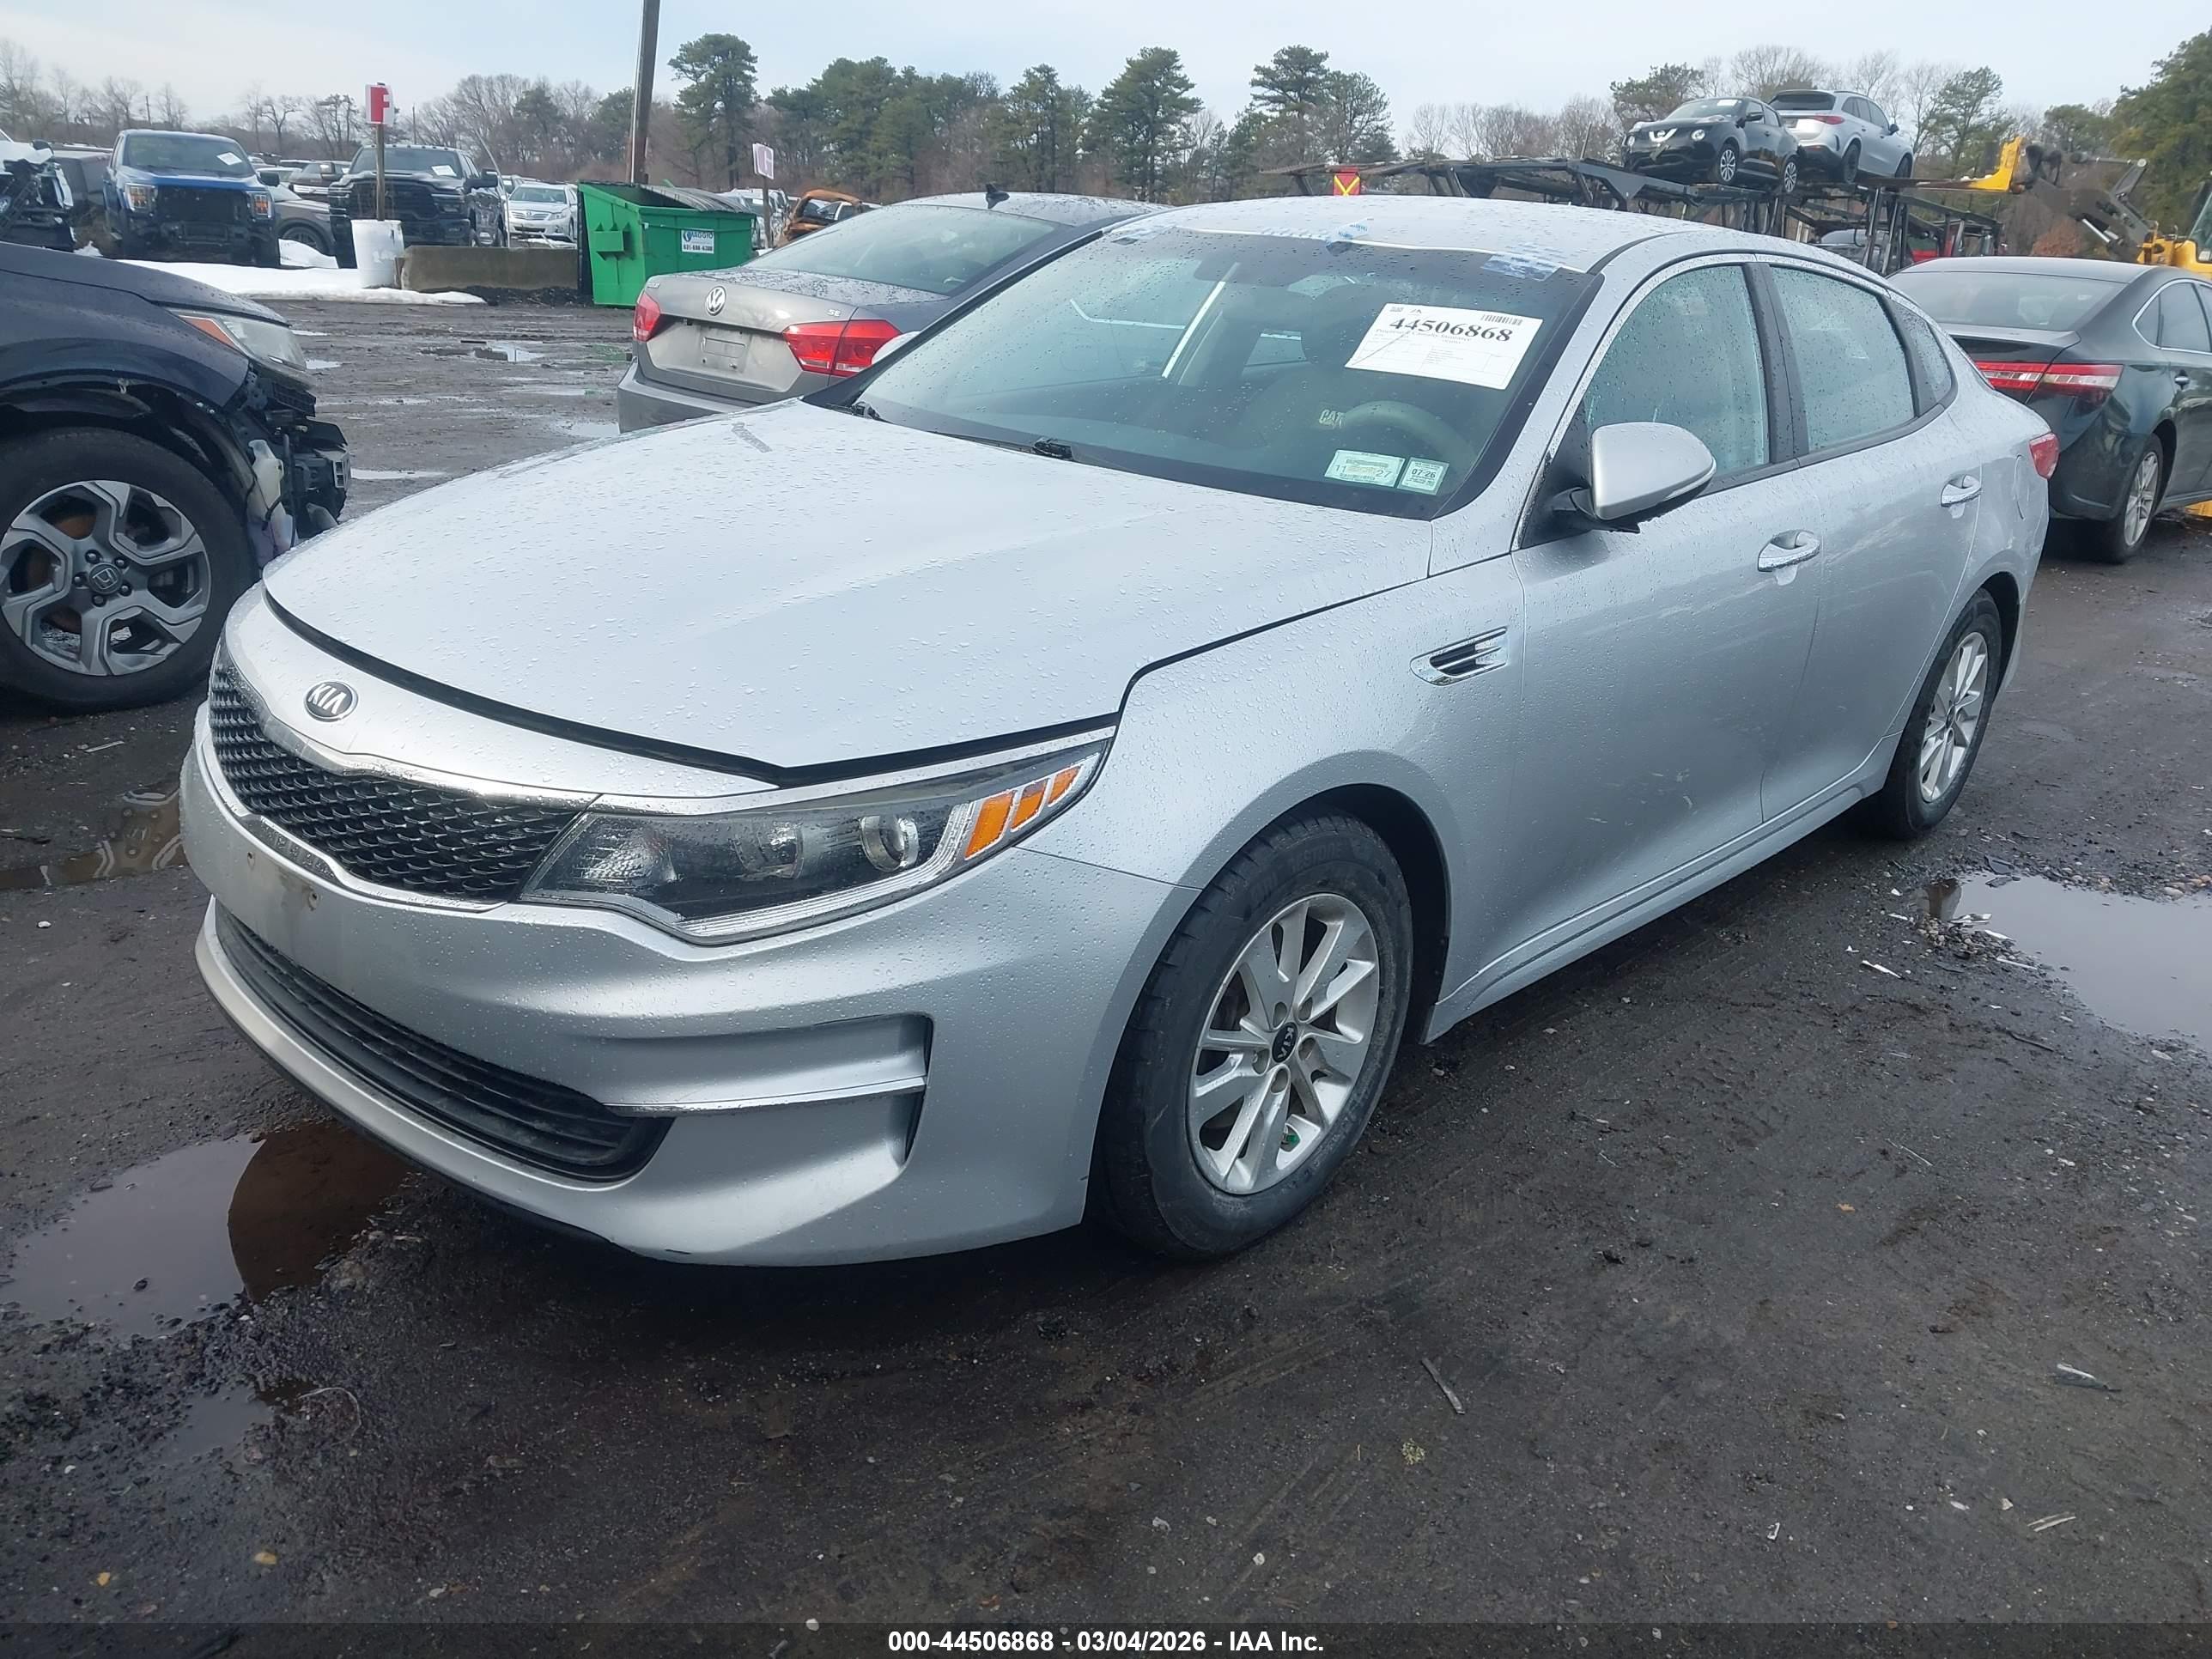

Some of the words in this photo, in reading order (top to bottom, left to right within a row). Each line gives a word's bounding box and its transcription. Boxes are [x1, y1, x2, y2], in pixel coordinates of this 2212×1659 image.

[370, 86, 390, 123] F
[827, 308, 842, 318] SE
[1389, 317, 1514, 343] 44506868
[1375, 469, 1391, 479] 27
[307, 683, 347, 714] KIA
[1277, 1027, 1295, 1060] KIA
